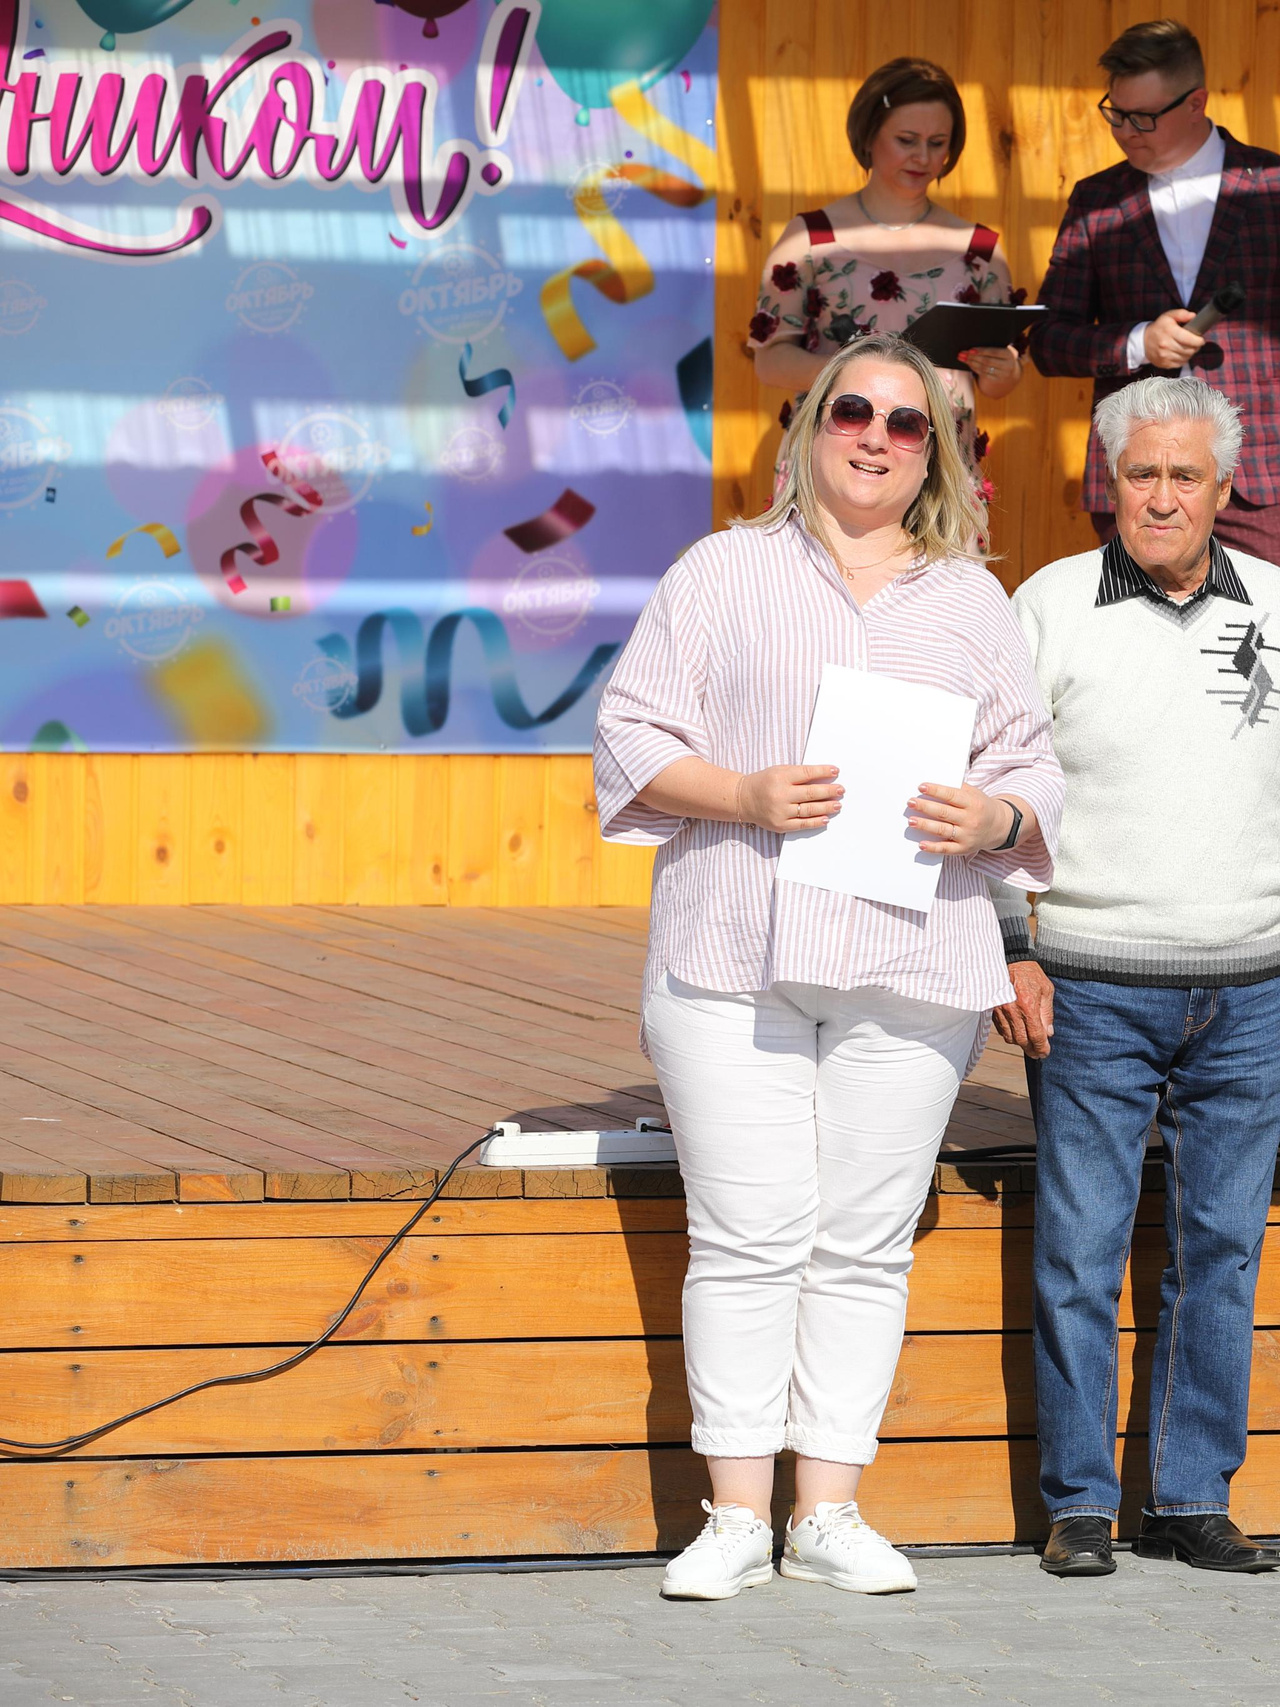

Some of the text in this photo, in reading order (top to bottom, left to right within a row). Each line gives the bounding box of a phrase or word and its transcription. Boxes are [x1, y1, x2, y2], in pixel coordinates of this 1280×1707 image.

[0, 0, 530, 228] ником!
[225, 281, 314, 312] ОКТЯБРЬ
[398, 271, 523, 316] ОКТЯБРЬ
[569, 396, 637, 420] ОКТЯБРЬ
[266, 440, 391, 485] ОКТЯБРЬ
[502, 578, 601, 614] ОКТЯБРЬ
[103, 602, 206, 639] ОКТЯБРЬ
